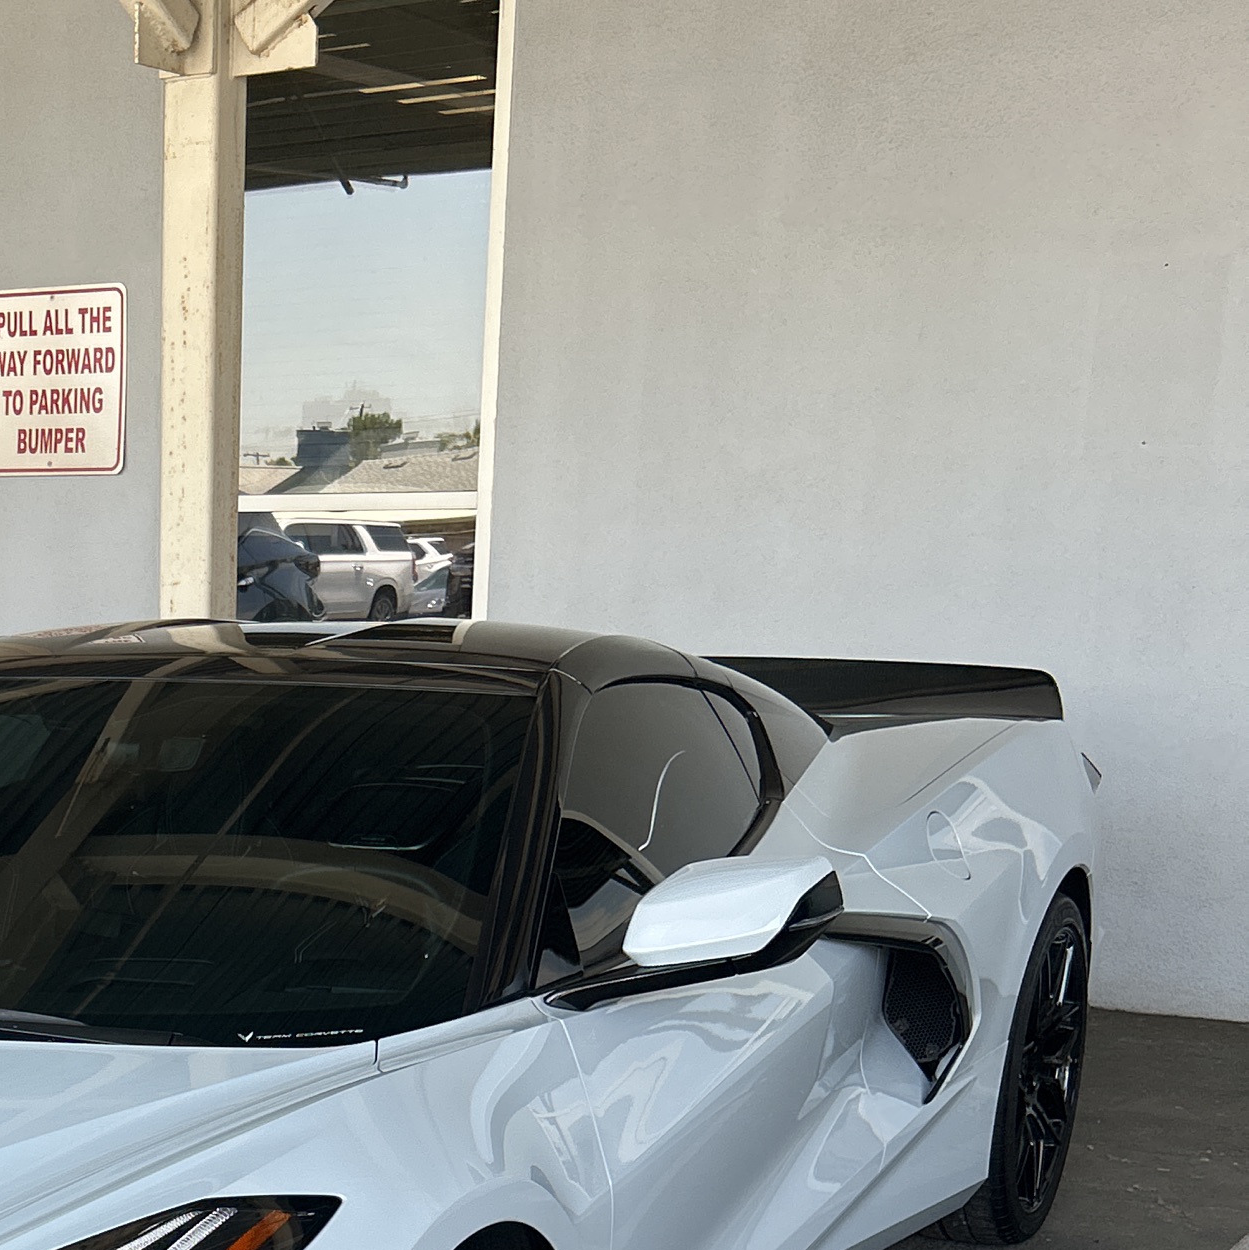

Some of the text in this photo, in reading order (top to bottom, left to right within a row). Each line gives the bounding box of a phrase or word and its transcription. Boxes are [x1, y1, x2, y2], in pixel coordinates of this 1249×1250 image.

[42, 308, 74, 336] ALL
[78, 306, 112, 334] THE
[33, 346, 116, 376] FORWARD
[2, 386, 104, 416] TO PARKING
[17, 427, 86, 454] BUMPER
[255, 1028, 364, 1041] TEAM CORVETTE
